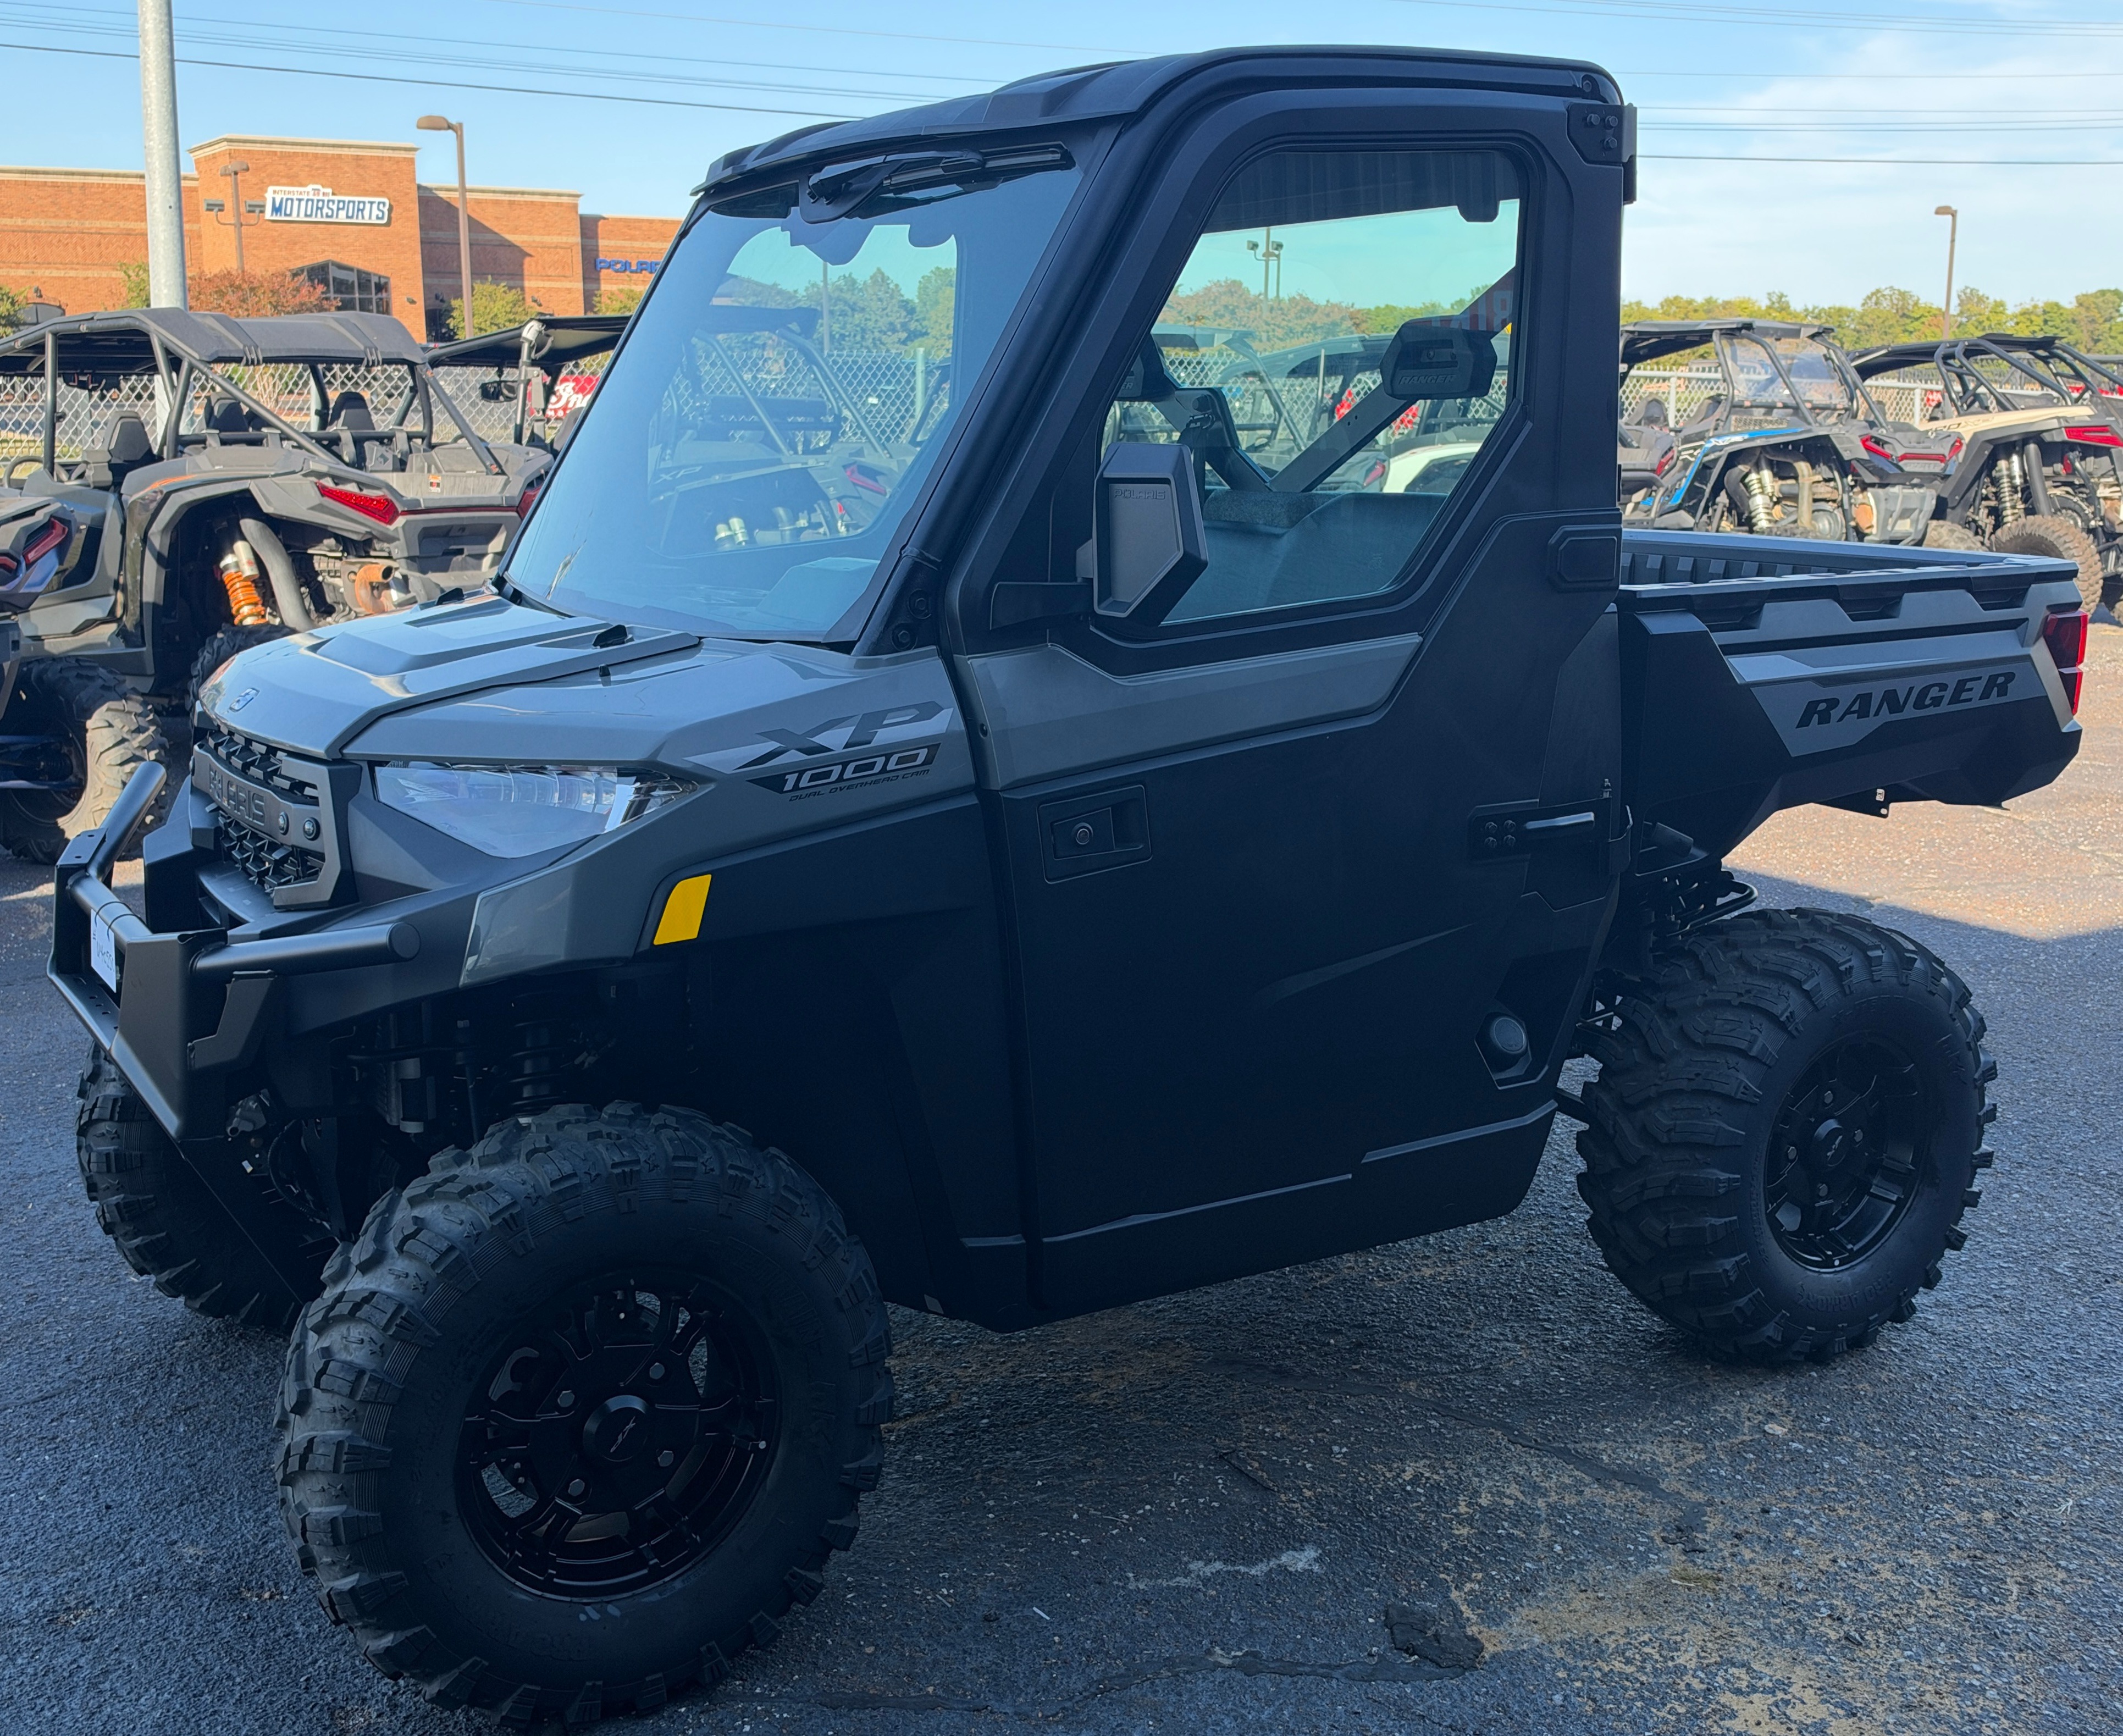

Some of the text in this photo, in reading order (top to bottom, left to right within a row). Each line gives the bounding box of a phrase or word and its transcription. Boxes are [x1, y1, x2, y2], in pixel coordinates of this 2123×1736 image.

[270, 197, 386, 220] MOTORSPORTS
[1114, 489, 1166, 500] POLARIS
[1795, 671, 2016, 729] RANGER
[732, 700, 944, 770] XP
[783, 748, 929, 792] 1000
[788, 769, 931, 802] DUAL OVERHEAD CAM
